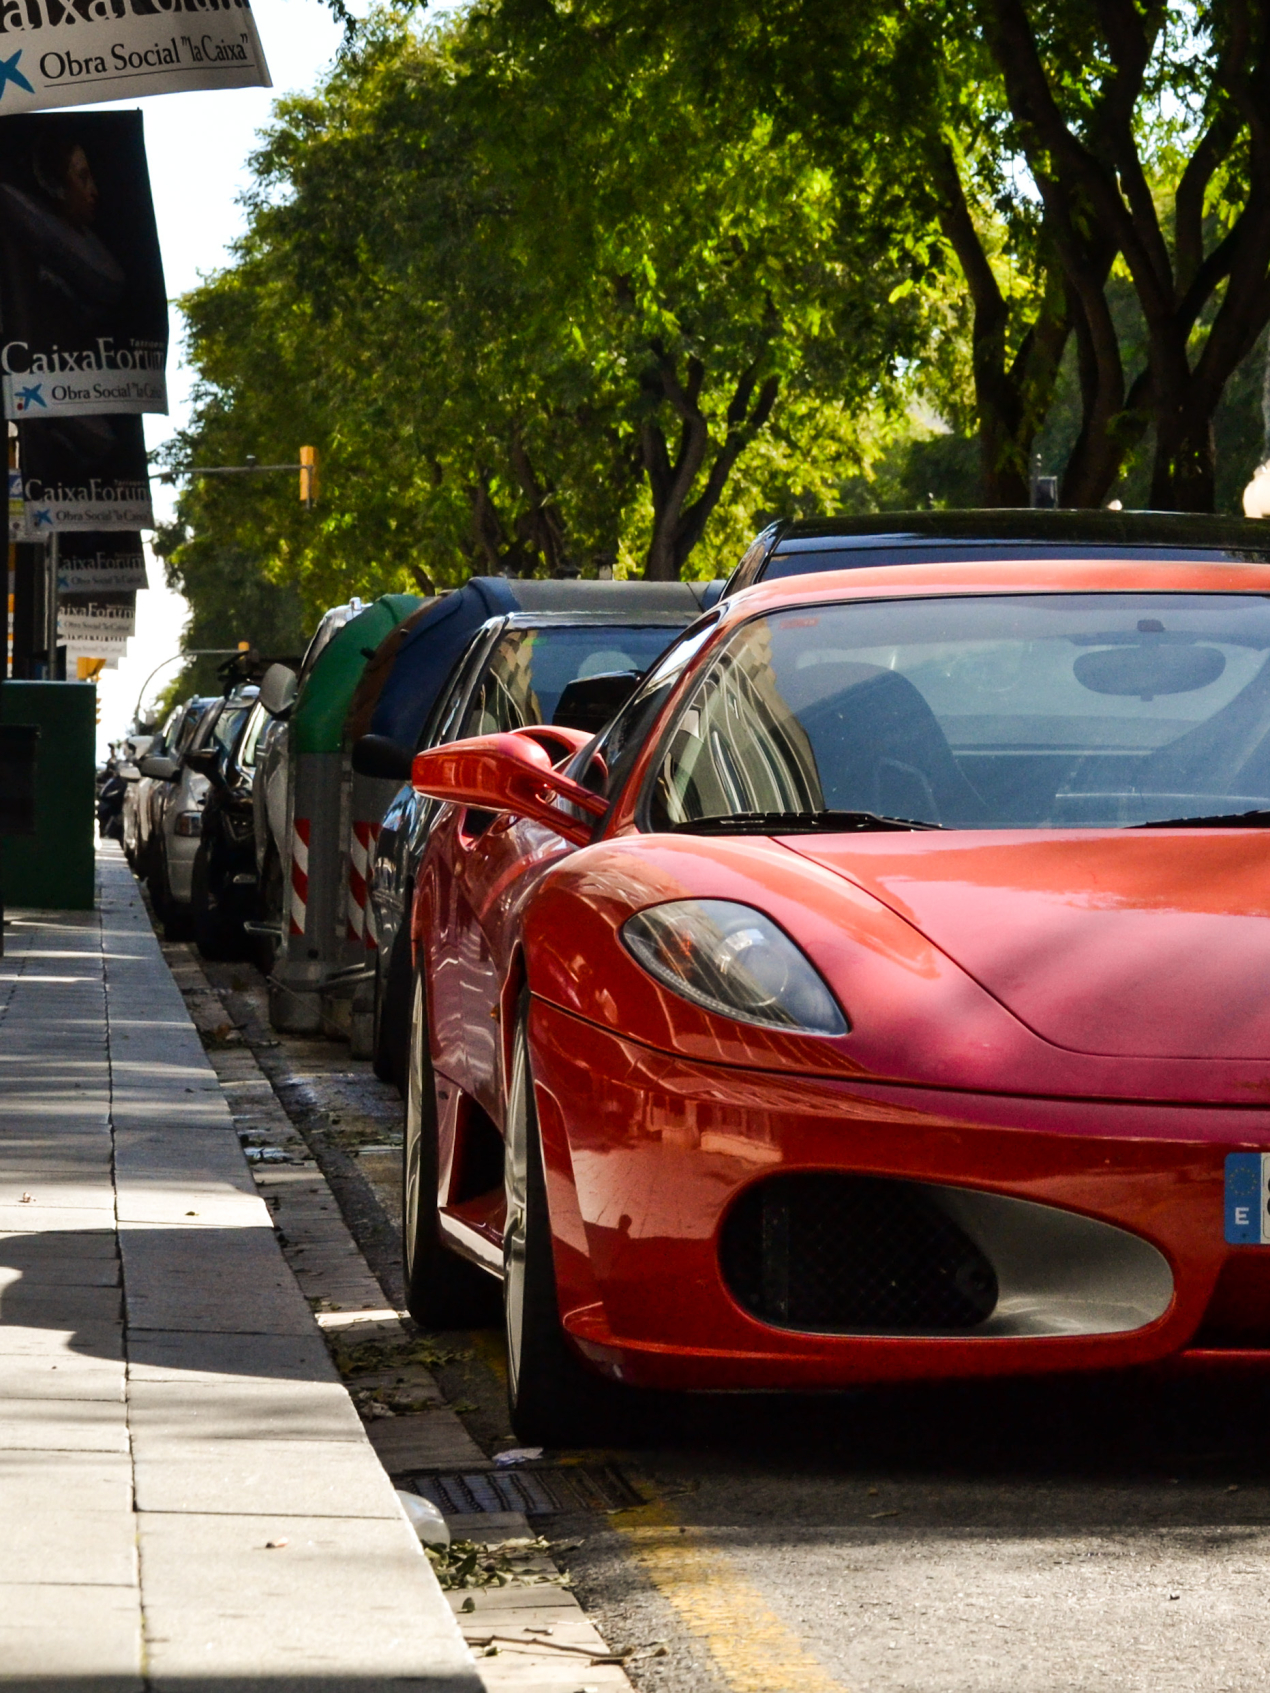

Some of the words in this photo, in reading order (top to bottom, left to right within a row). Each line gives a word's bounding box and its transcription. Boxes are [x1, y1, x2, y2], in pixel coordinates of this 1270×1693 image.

[40, 51, 107, 79] Obra
[111, 38, 181, 70] Social
[1, 337, 165, 374] CaixaForum
[52, 385, 91, 400] Obra
[93, 383, 130, 399] Social
[57, 552, 144, 570] aixaForum
[57, 602, 135, 618] aixaForum
[1234, 1207, 1249, 1225] E
